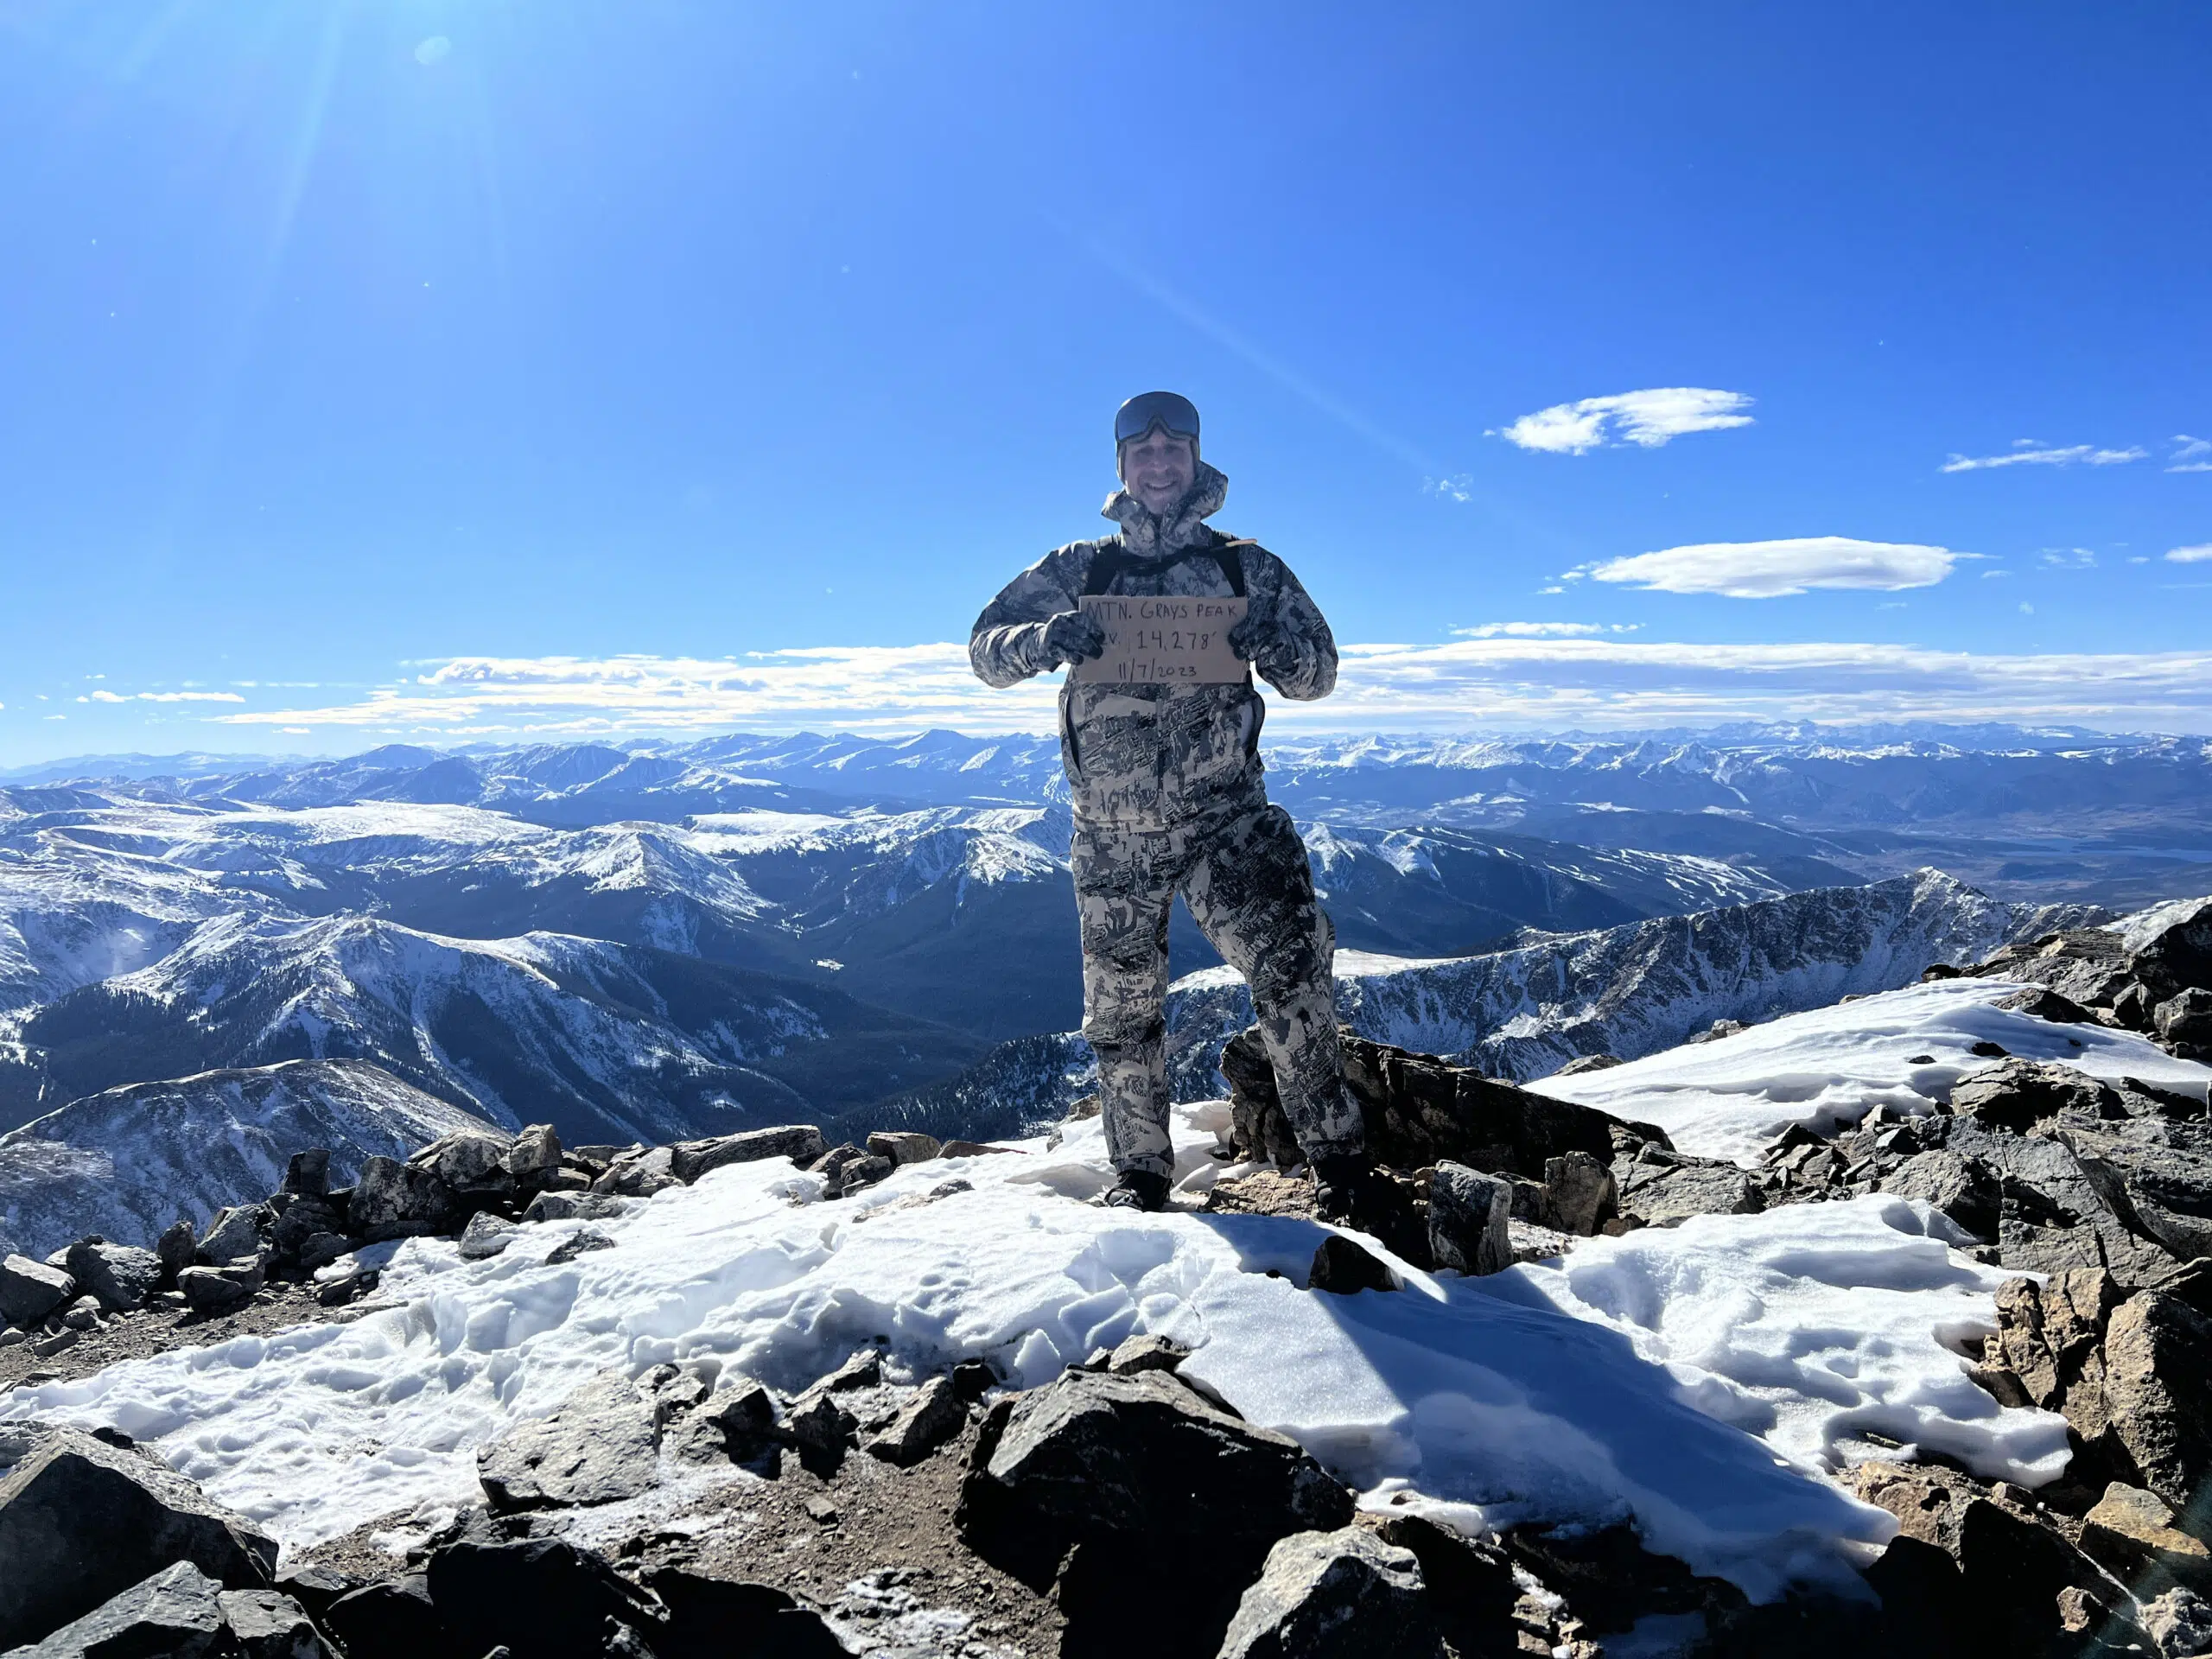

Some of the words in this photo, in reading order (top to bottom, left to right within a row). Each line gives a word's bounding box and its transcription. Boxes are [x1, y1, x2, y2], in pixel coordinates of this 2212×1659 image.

[1086, 601, 1133, 620] MTN.
[1141, 601, 1188, 620] GRAYS
[1197, 603, 1238, 618] PEAK
[1119, 658, 1198, 683] 11/7/2023
